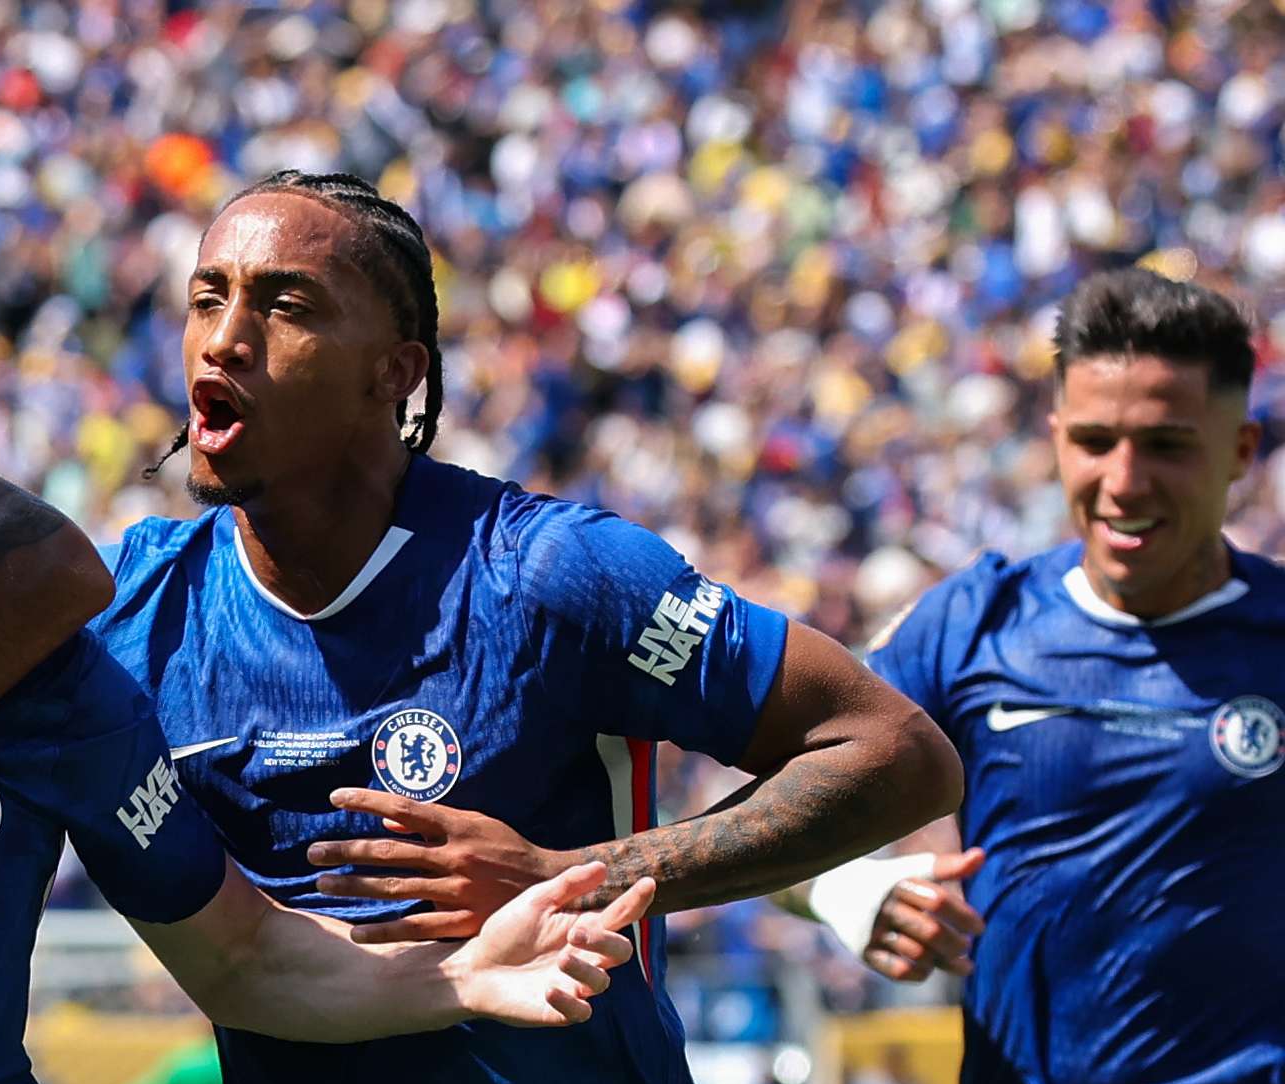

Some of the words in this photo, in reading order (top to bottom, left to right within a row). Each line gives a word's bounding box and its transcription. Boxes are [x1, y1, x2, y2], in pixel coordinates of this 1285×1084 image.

[627, 591, 689, 673] LIVE
[387, 713, 445, 735] CHELSEA
[262, 731, 277, 739] FIFA
[275, 749, 300, 758] SUNDAY
[312, 750, 327, 758] JULY
[264, 758, 278, 766] NEW
[278, 759, 298, 768] YORK,
[298, 759, 314, 767] NEW
[116, 755, 170, 831] LIVE
[425, 783, 446, 798] CLUB
[131, 764, 182, 850] NAT
